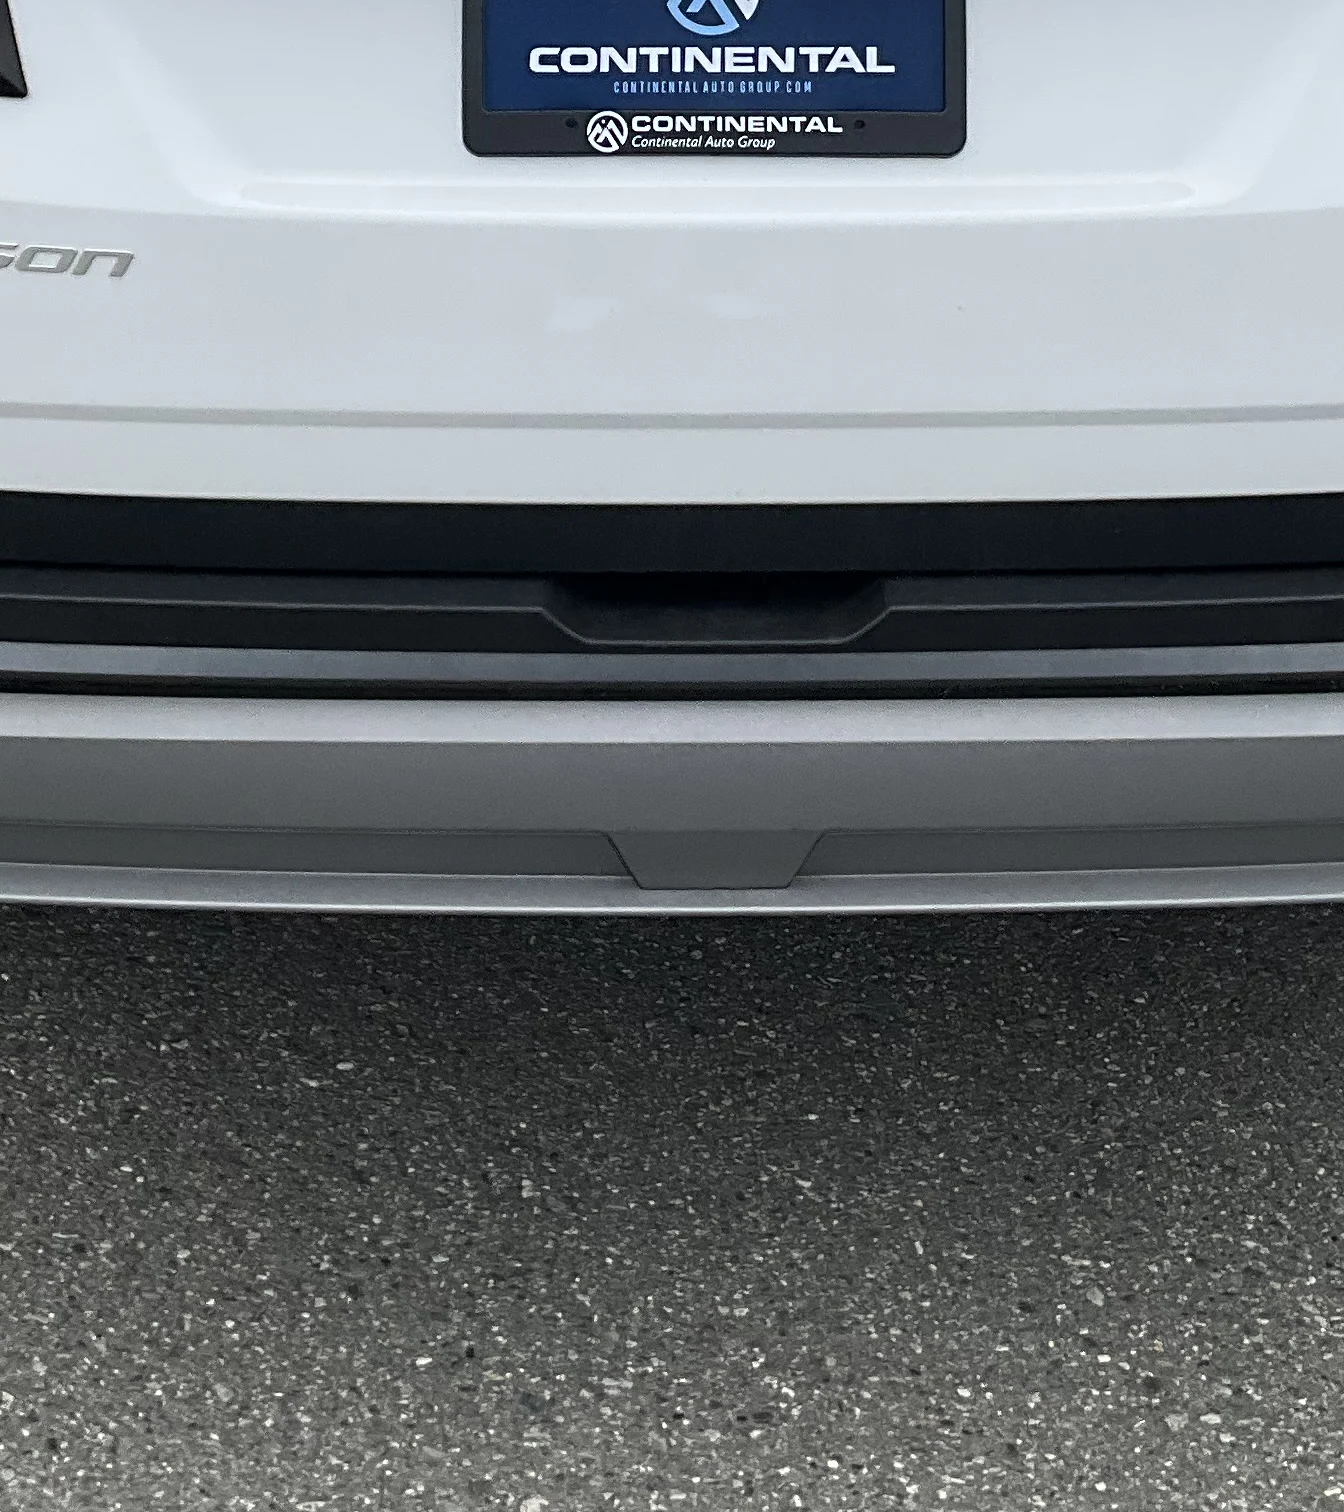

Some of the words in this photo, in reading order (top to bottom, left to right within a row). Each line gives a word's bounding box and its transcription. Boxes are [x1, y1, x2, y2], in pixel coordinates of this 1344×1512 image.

[529, 46, 895, 73] CONTINENTAL
[631, 115, 843, 133] CONTINENTAL
[631, 135, 702, 148] Continental
[704, 136, 735, 148] Auto
[737, 136, 776, 151] Group
